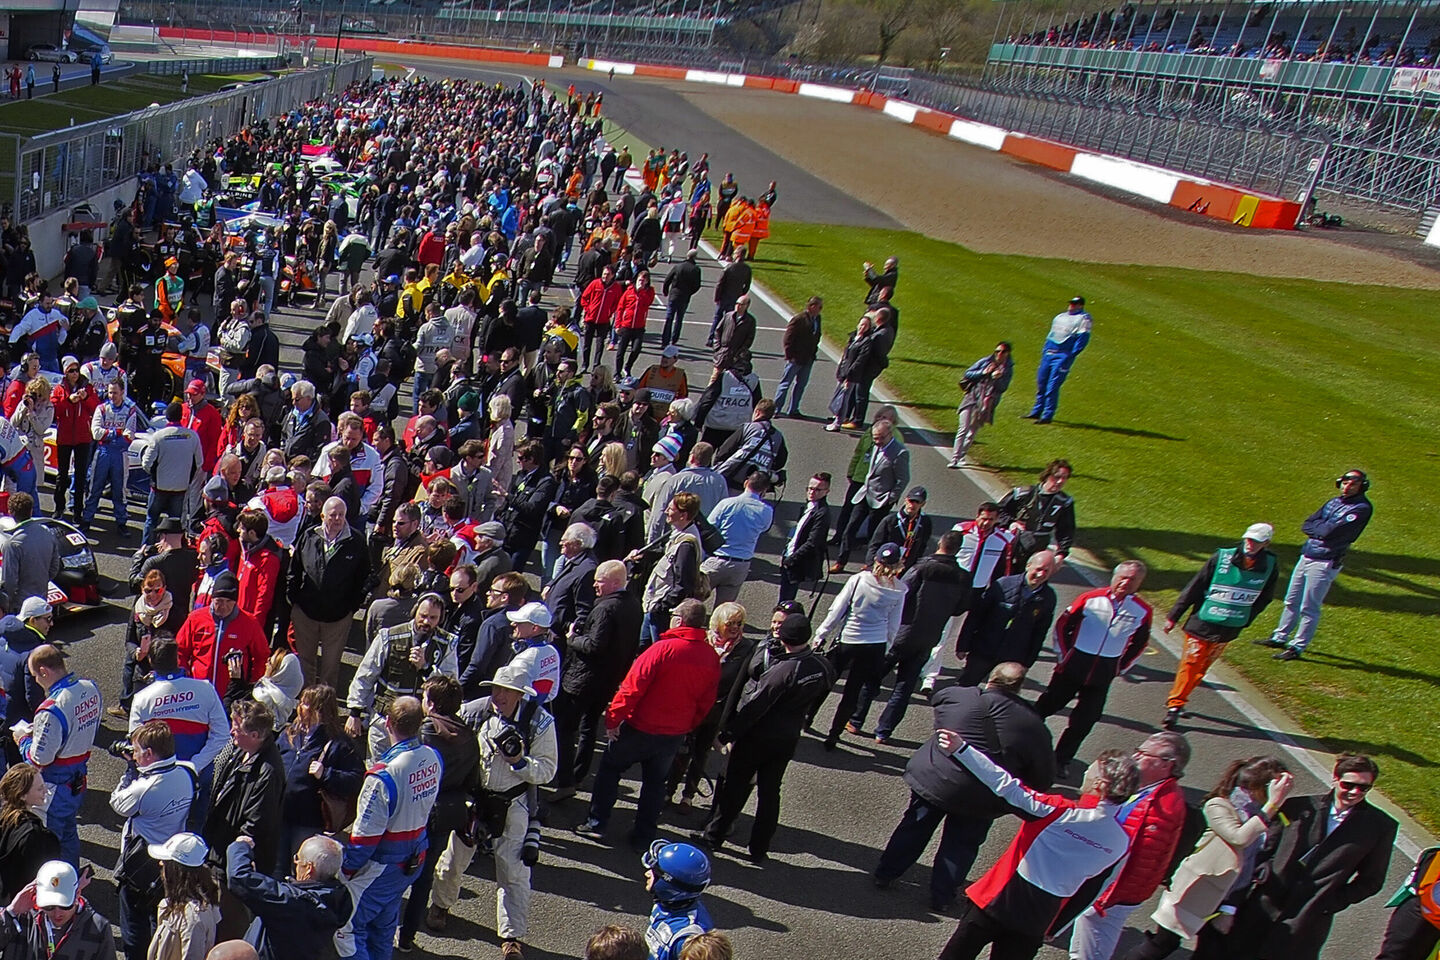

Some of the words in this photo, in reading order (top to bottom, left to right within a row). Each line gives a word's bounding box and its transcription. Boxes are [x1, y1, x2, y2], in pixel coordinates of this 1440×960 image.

[227, 190, 253, 199] ALPINE
[720, 397, 751, 408] TRACK
[1050, 505, 1060, 518] 7
[1218, 553, 1233, 575] 2015
[1231, 591, 1258, 602] LANE
[432, 650, 441, 664] 9
[74, 695, 98, 716] DENSO
[154, 691, 194, 708] DENSO
[77, 708, 99, 724] TOYOTA
[153, 709, 175, 718] TOYOTA
[175, 704, 200, 713] HYBRID
[409, 764, 439, 784] DENSO
[412, 778, 437, 795] TOYOTA
[1064, 828, 1113, 855] PORSCHE
